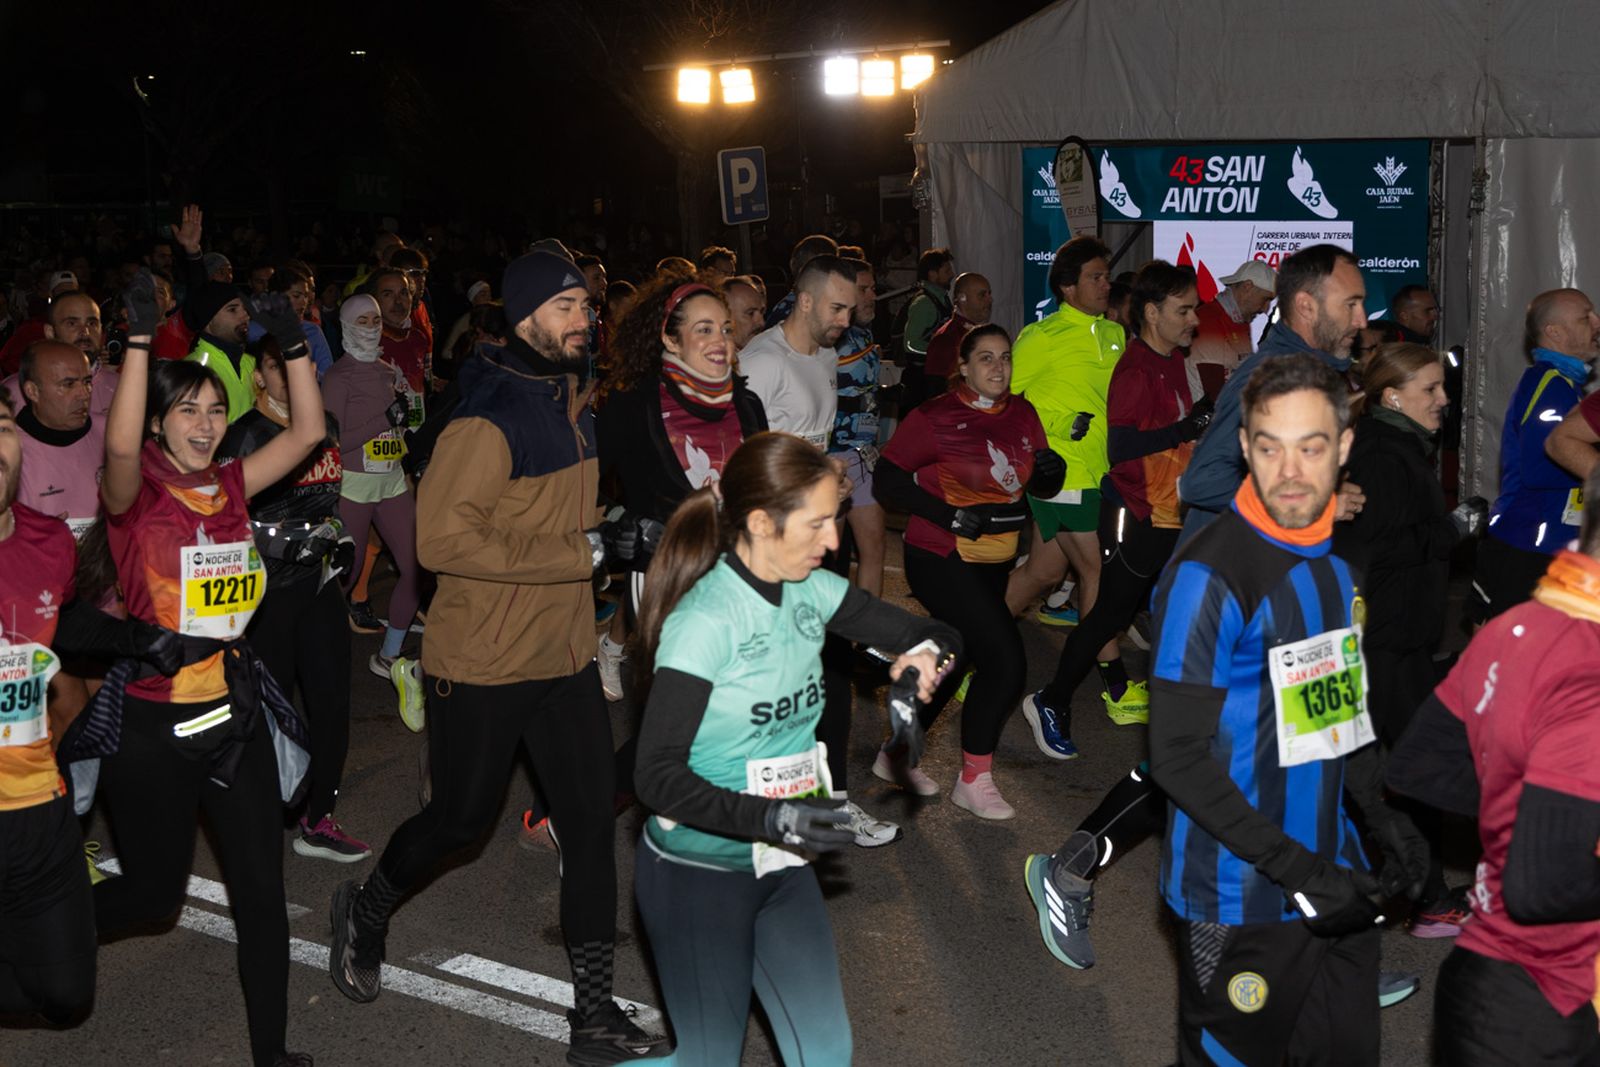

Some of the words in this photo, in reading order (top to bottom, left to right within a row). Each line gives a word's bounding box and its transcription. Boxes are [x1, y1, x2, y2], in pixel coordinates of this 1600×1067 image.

[1168, 155, 1205, 185] 43
[1204, 155, 1266, 182] SAN
[730, 157, 757, 214] P
[1365, 187, 1386, 196] CAJA
[1386, 187, 1414, 196] RURAL
[1109, 187, 1127, 207] 43
[1160, 179, 1260, 213] ANTÓN
[1301, 186, 1322, 207] 43
[1256, 231, 1290, 240] CARRERA
[1290, 231, 1320, 240] URBANA
[1255, 241, 1286, 251] NOCHE
[1288, 241, 1301, 251] DE
[1357, 257, 1420, 268] calderón
[205, 555, 232, 566] NOCHE
[233, 552, 242, 562] DE
[194, 568, 213, 578] SAN
[200, 574, 256, 607] 12217
[1297, 647, 1323, 664] NOCHE
[1324, 643, 1333, 657] DE
[1286, 669, 1307, 684] SAN
[0, 678, 41, 713] 394
[1299, 671, 1357, 719] 1363
